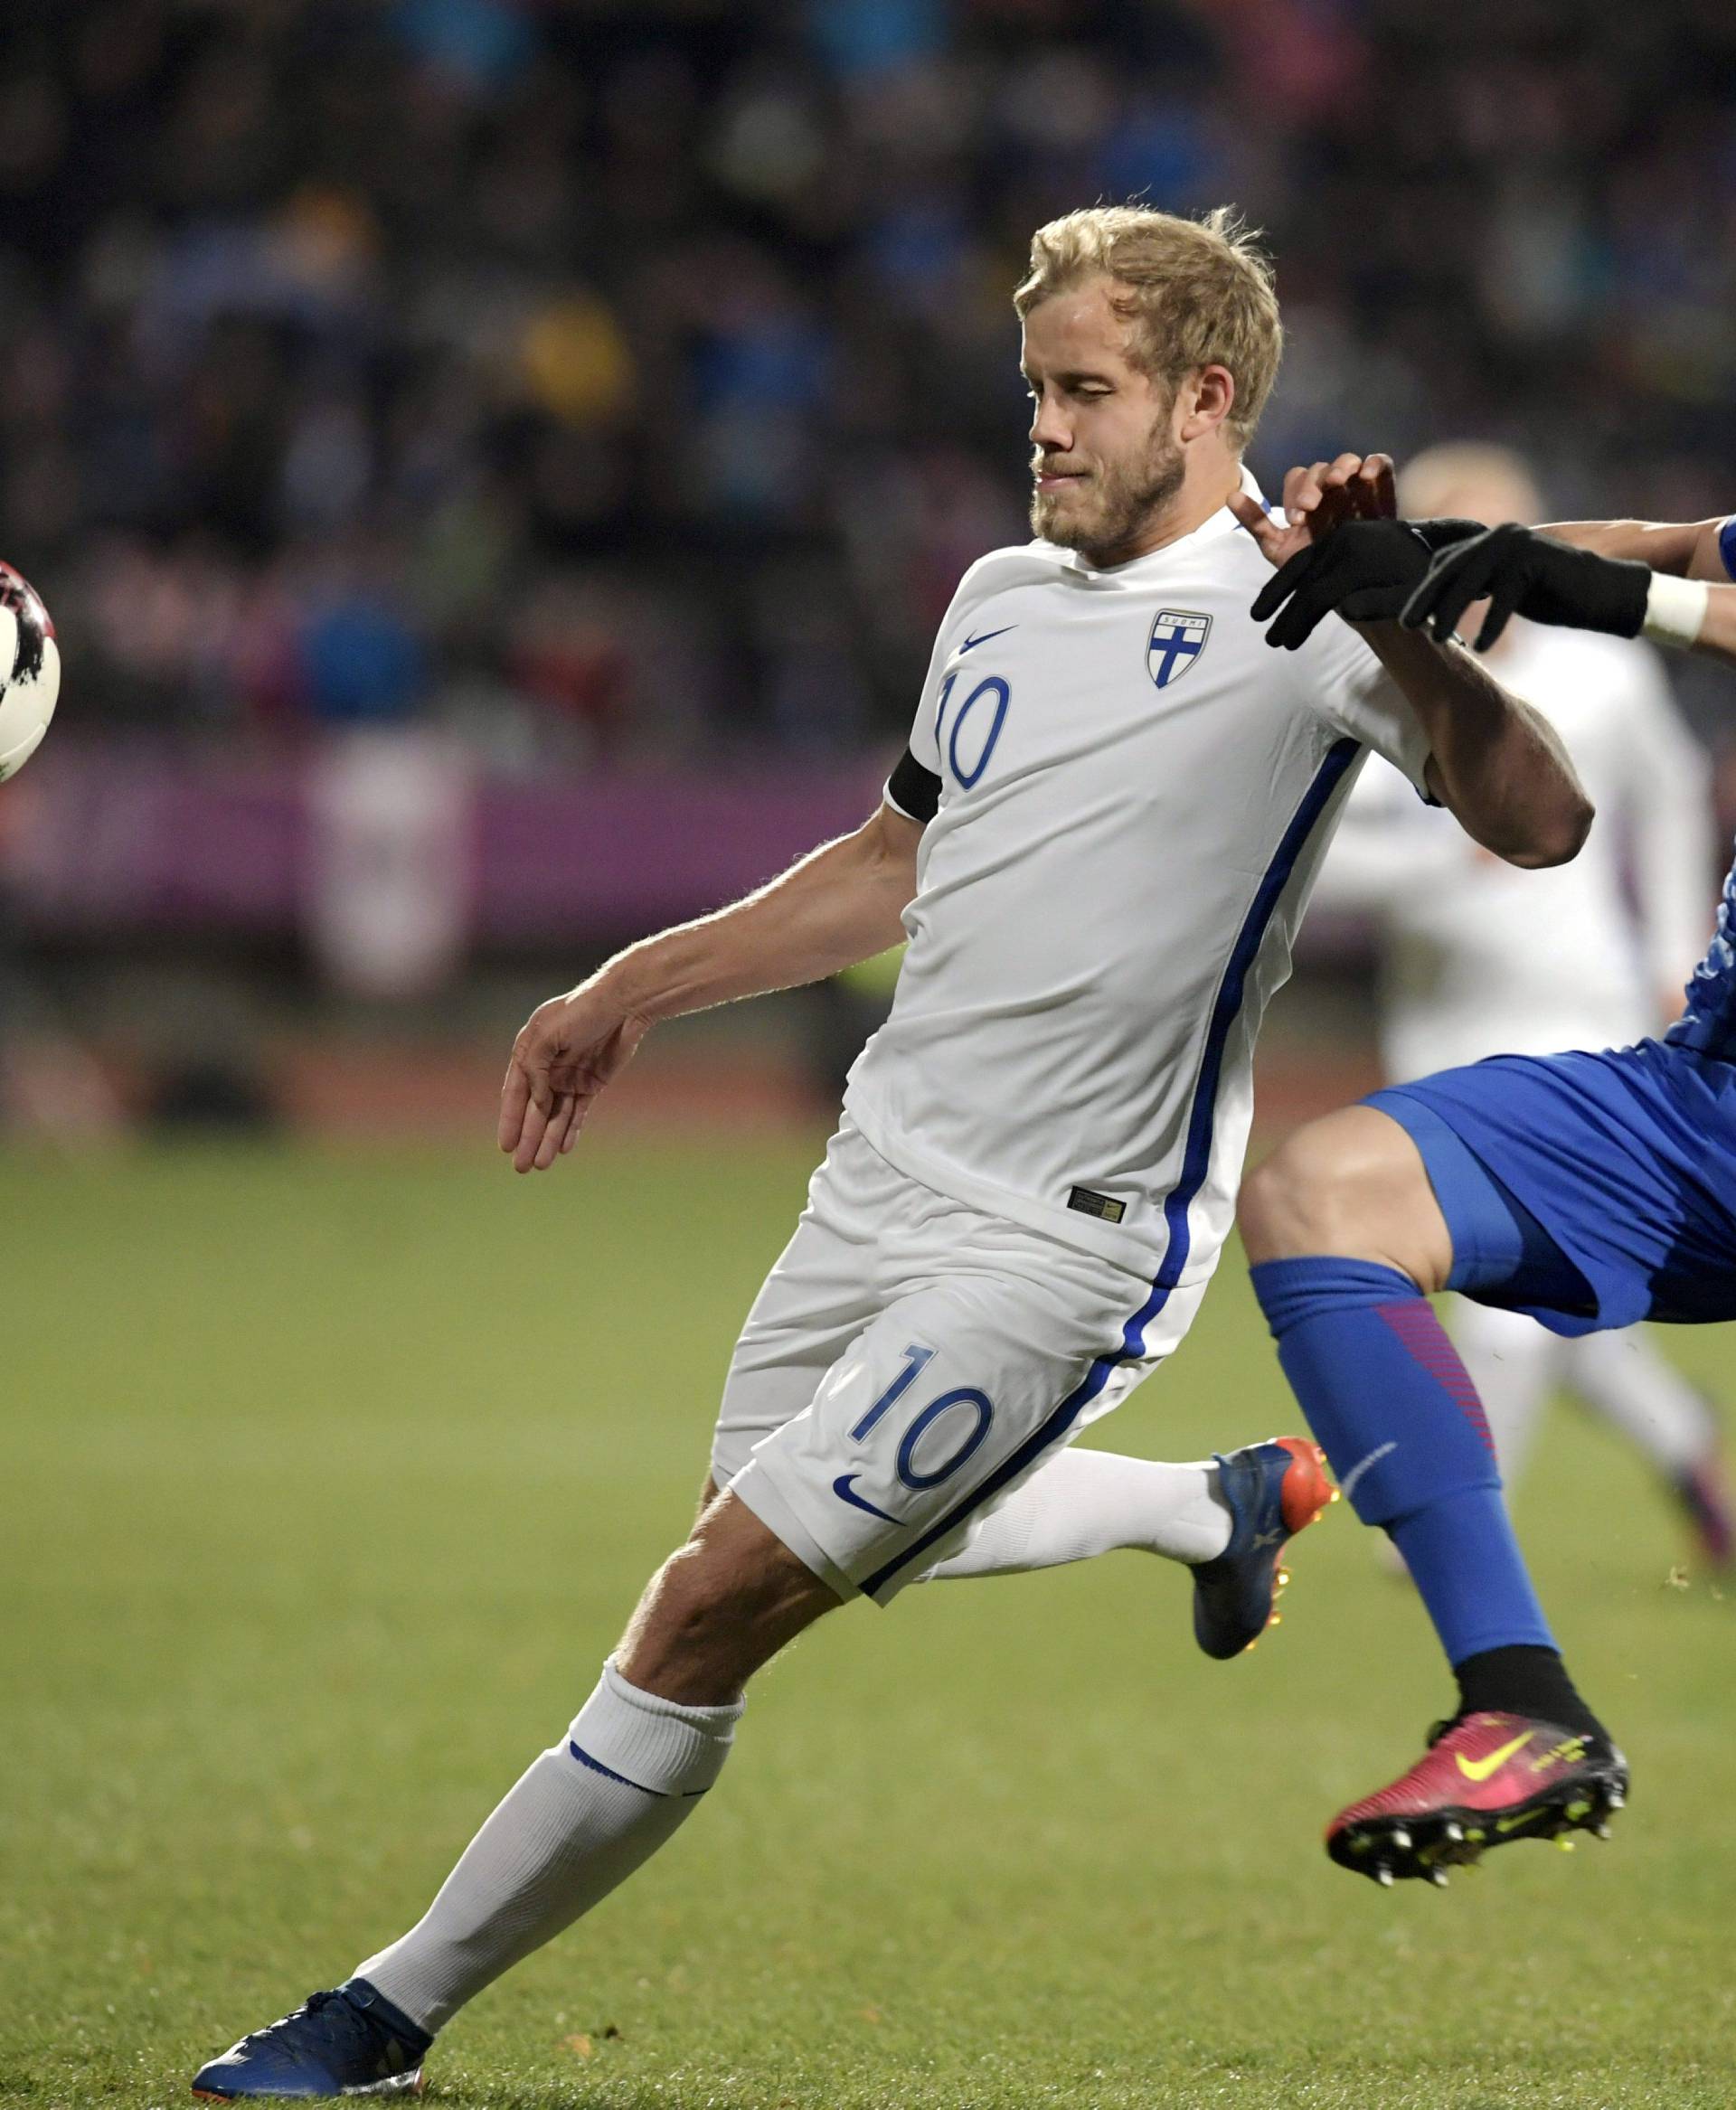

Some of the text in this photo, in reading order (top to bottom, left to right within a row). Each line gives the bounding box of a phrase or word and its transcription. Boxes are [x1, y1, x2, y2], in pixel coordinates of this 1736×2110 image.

[1164, 617, 1203, 626] SUOMI
[935, 674, 1011, 793] 10
[847, 1342, 995, 1492] 10
